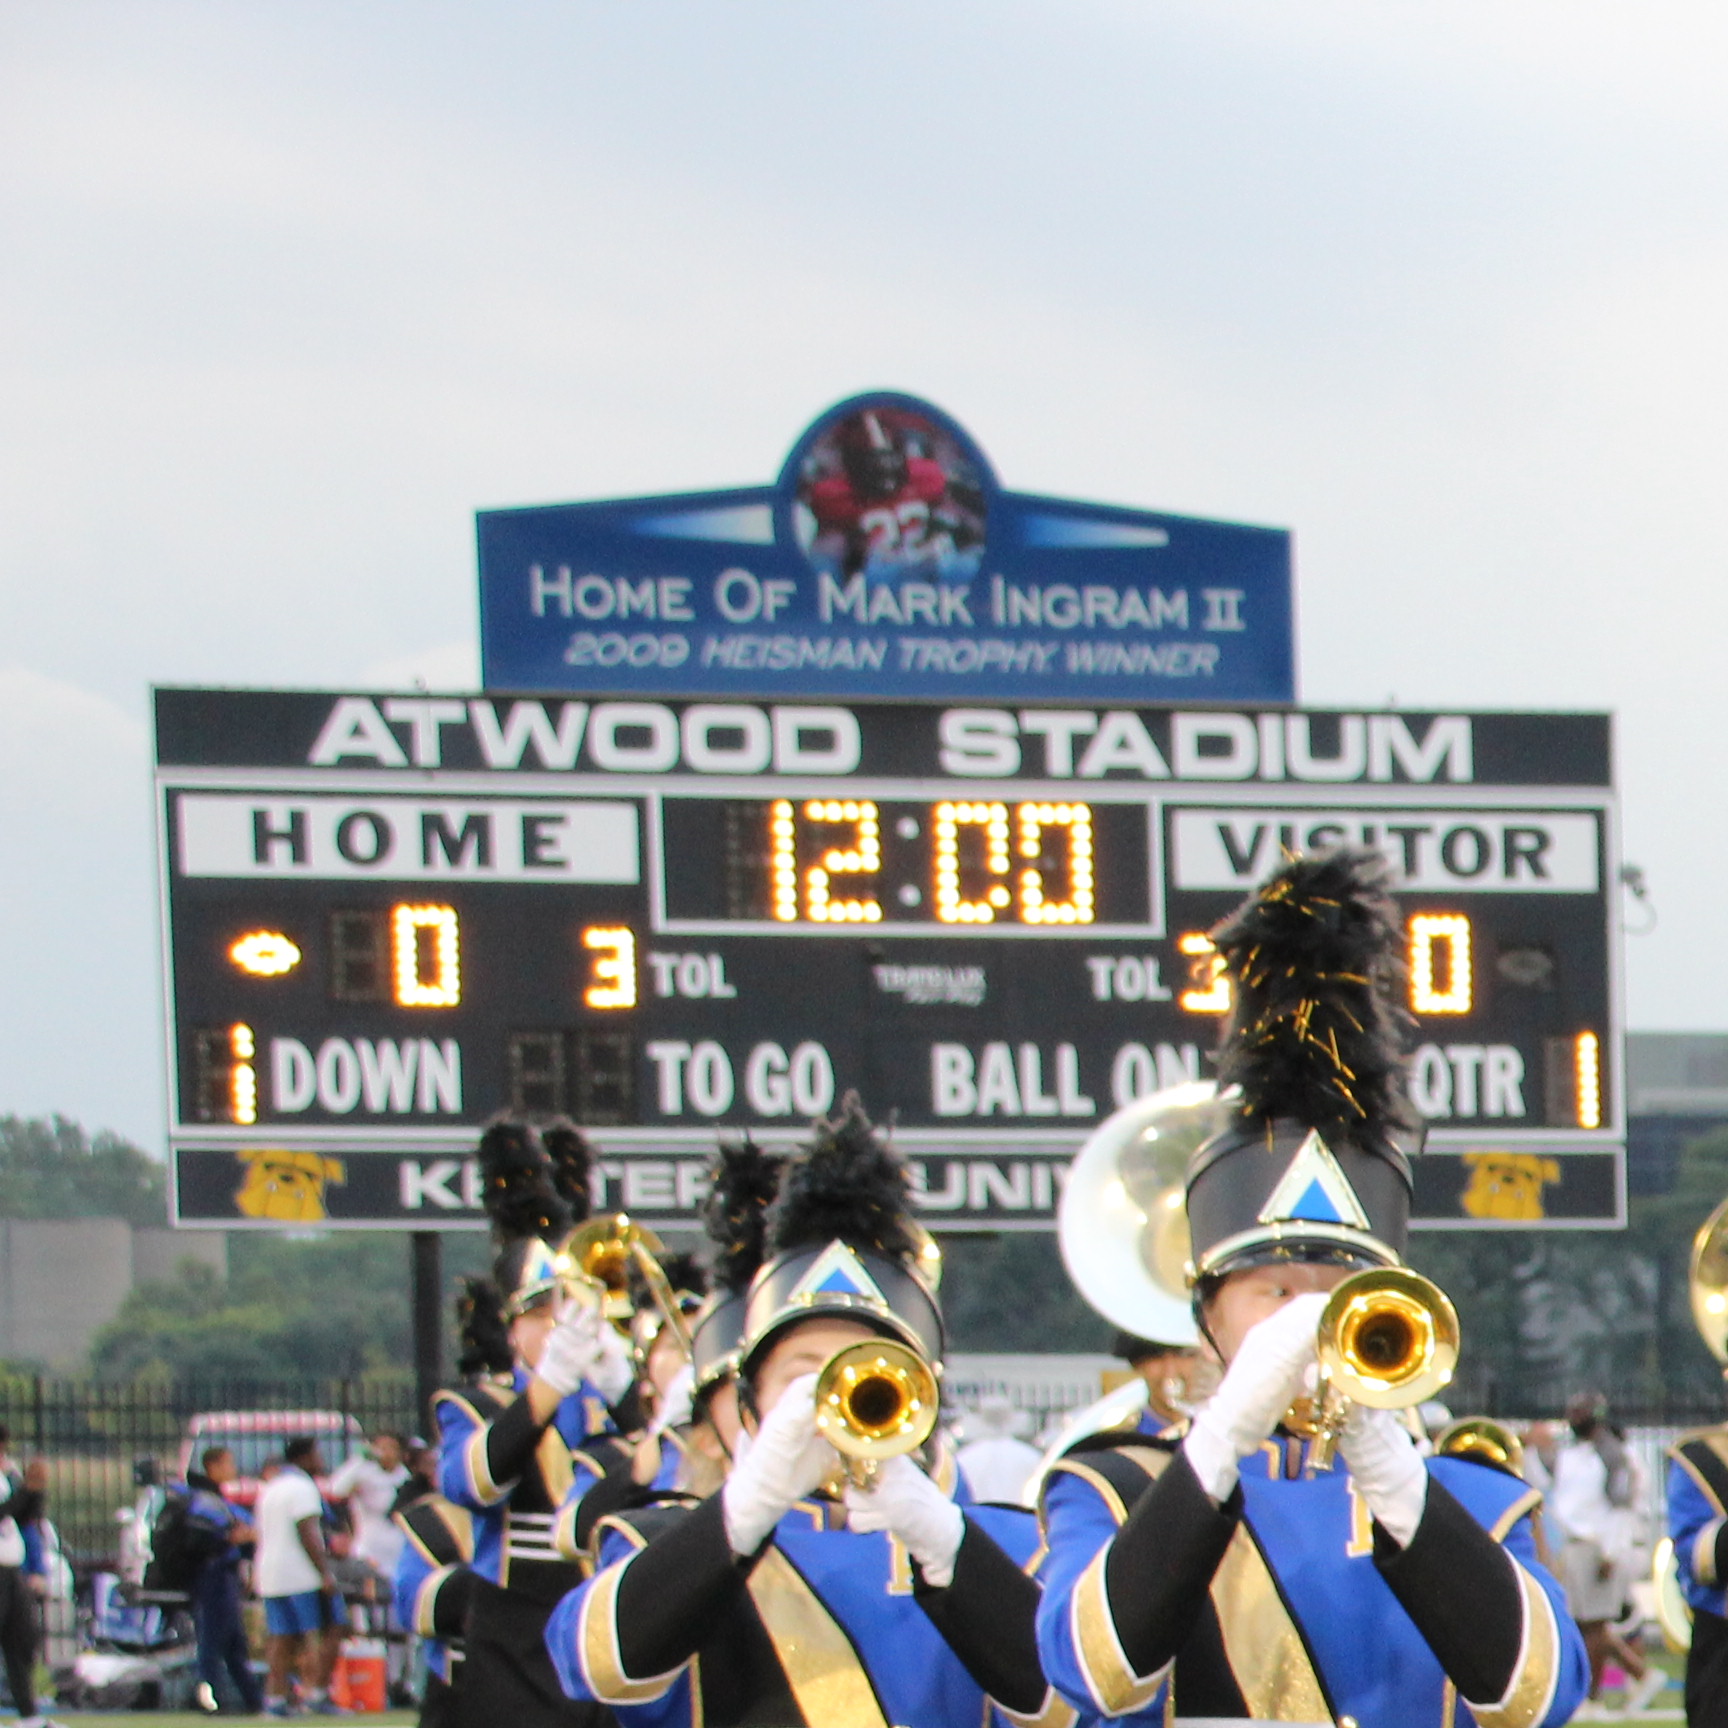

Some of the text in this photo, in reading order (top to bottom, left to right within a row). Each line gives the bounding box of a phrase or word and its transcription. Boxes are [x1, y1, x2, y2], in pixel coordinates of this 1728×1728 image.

[529, 566, 1245, 632] HOME OF MARK INGRAM II
[565, 633, 1219, 676] 2009 HEISMAN TROPHY WINNER
[309, 697, 1473, 783] ATWOOD STADIUM
[253, 809, 570, 871] HOME
[770, 798, 1096, 924] 12:00
[394, 902, 461, 1007] 0
[582, 926, 638, 1008] 3
[649, 951, 736, 999] TOL
[1085, 954, 1173, 1001] TOL
[1176, 930, 1231, 1013] 3
[1409, 914, 1472, 1015] 0
[231, 1021, 257, 1126] 1
[270, 1037, 462, 1114] DOWN
[649, 1040, 834, 1117] TO GO
[931, 1043, 1096, 1117] BALL
[1415, 1043, 1526, 1118] QTR
[1575, 1030, 1602, 1130] 1
